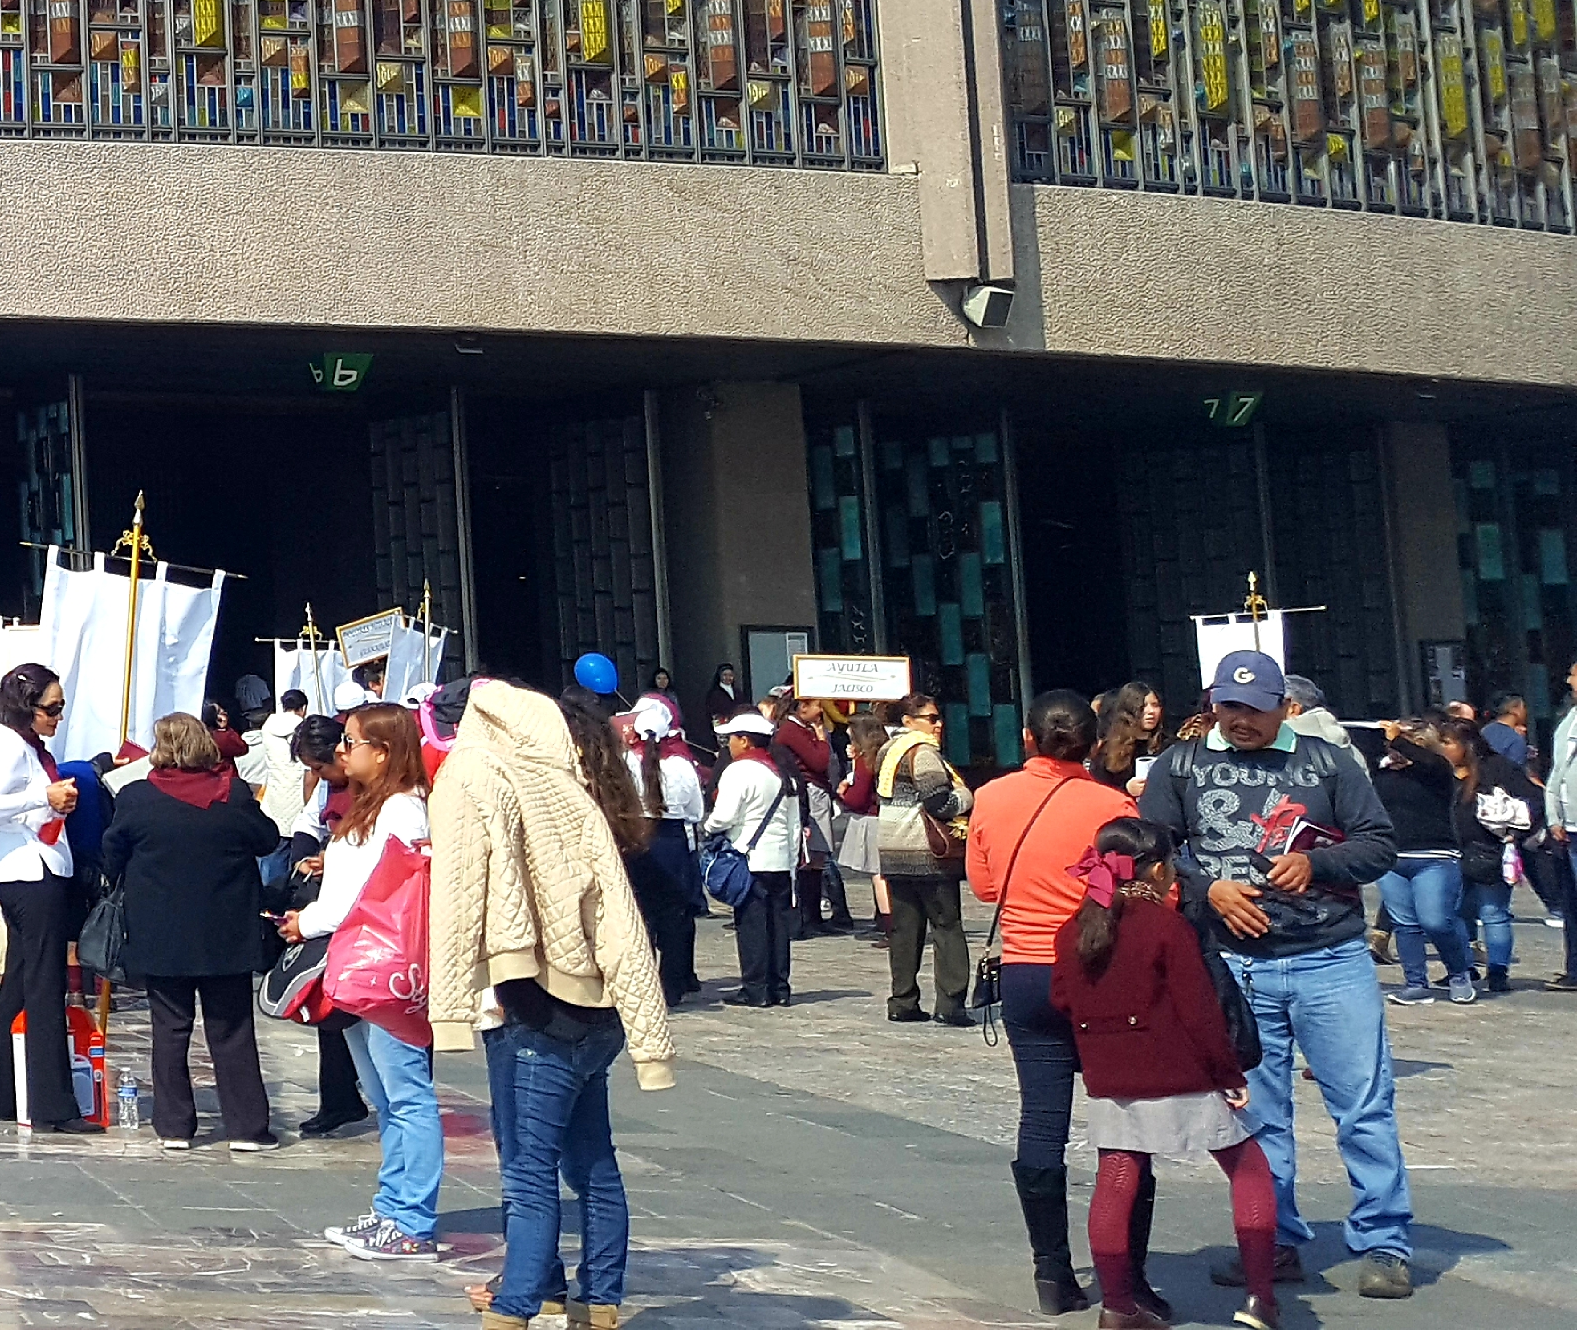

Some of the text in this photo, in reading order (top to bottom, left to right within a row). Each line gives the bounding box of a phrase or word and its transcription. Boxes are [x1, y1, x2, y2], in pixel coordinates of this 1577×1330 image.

[1203, 398, 1221, 420] 7
[1233, 397, 1256, 423] 7
[831, 683, 874, 693] JALISCO
[1192, 762, 1320, 788] YOUNG
